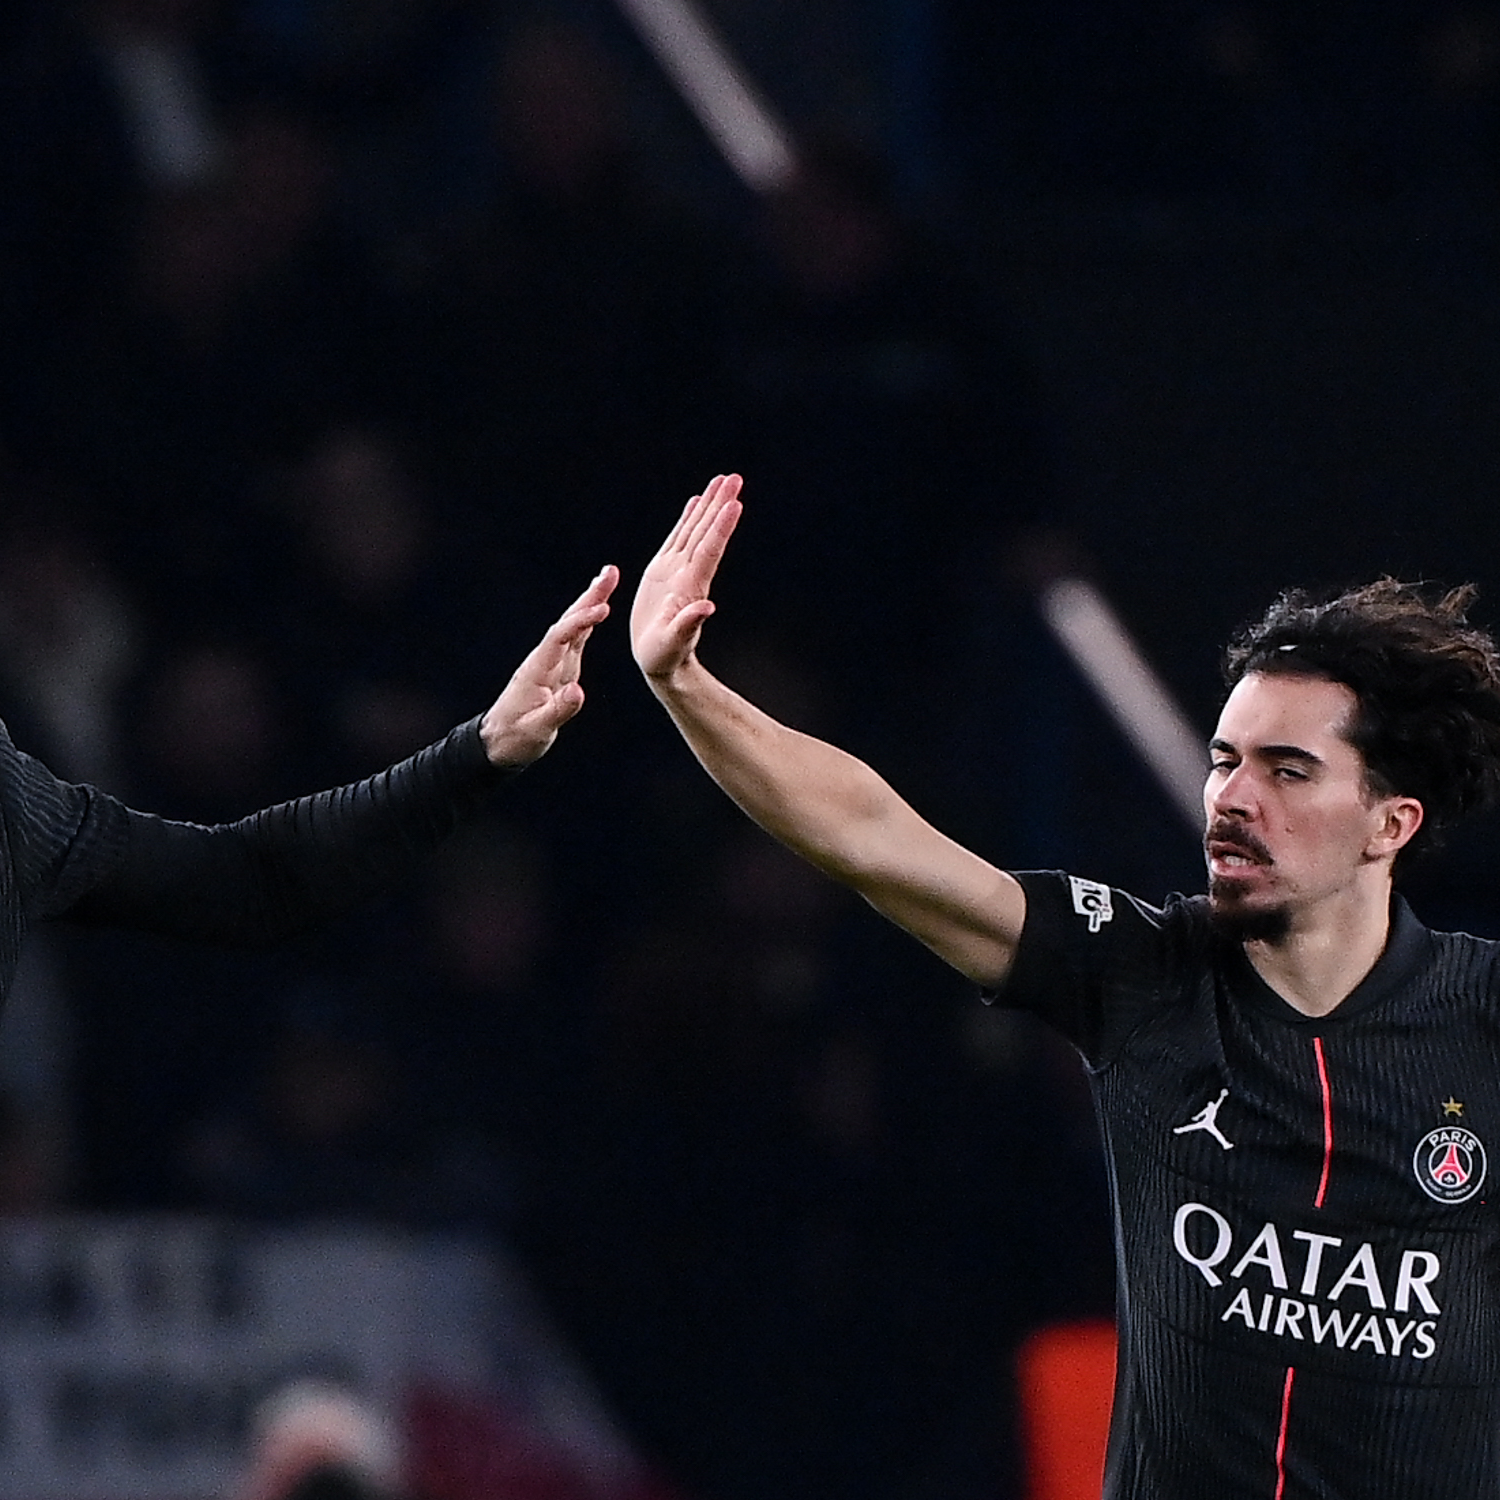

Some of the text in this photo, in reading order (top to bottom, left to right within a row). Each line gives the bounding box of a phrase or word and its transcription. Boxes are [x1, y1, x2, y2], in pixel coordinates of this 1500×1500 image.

[1428, 1131, 1477, 1152] PARIS
[1173, 1202, 1441, 1315] QATAR
[1221, 1287, 1438, 1360] AIRWAYS
